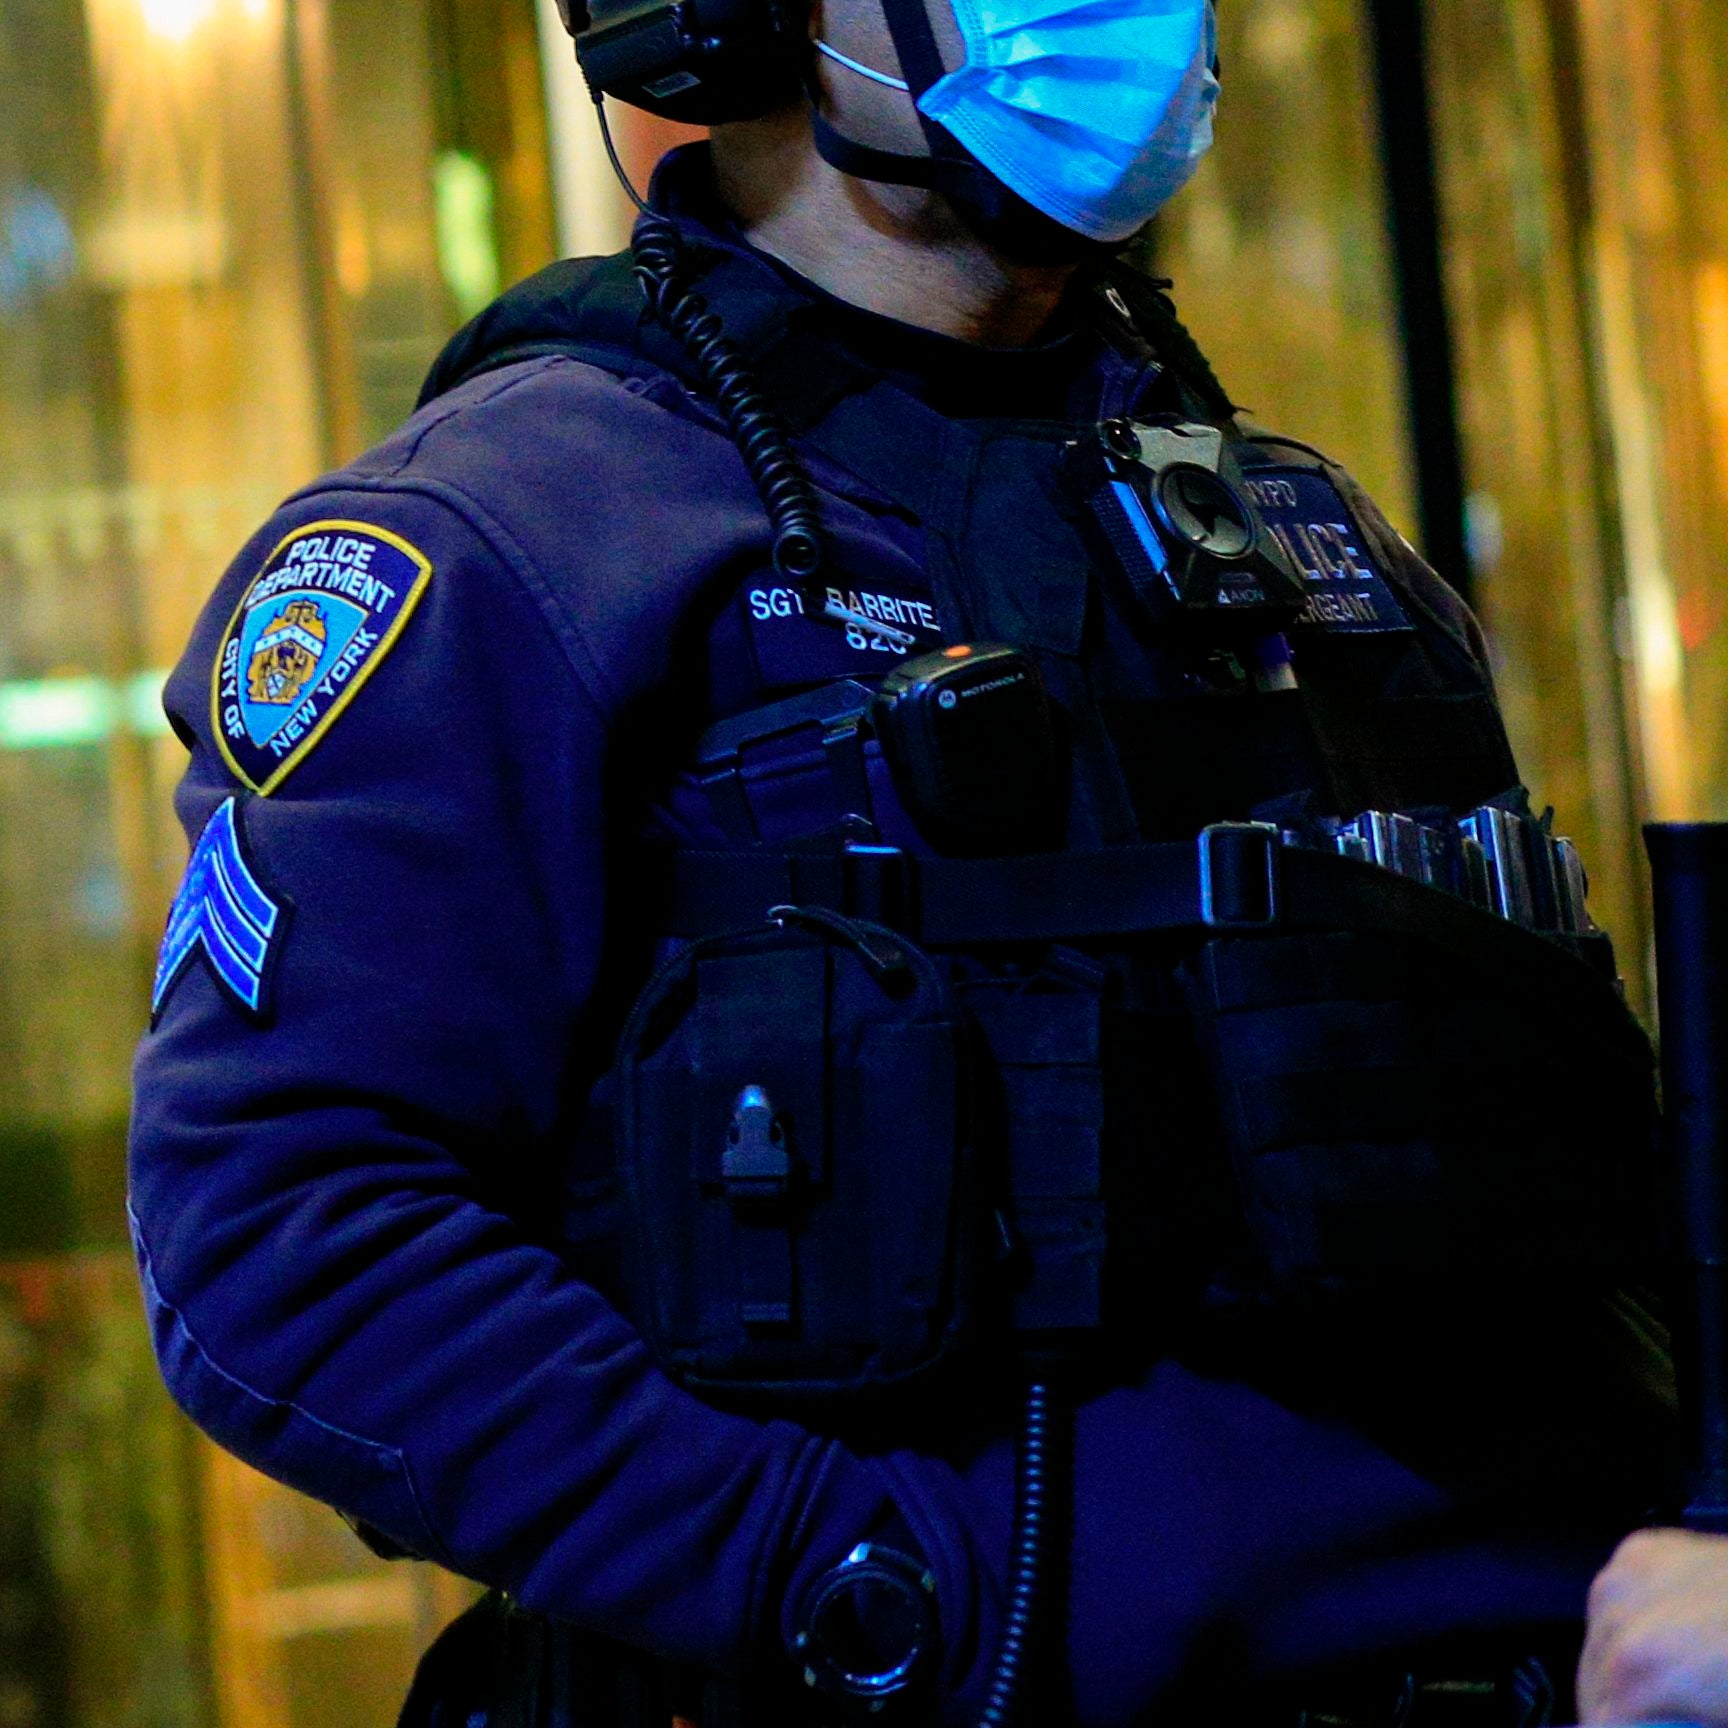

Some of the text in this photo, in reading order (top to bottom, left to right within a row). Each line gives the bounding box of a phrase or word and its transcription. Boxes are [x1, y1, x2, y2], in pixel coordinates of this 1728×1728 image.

[286, 535, 377, 571] POLICE
[1272, 523, 1374, 580] LICE
[245, 560, 396, 614] DEPARTMENT
[1295, 592, 1379, 623] RGEANT
[221, 637, 246, 740] CITY OF
[269, 627, 379, 758] NEW YORK
